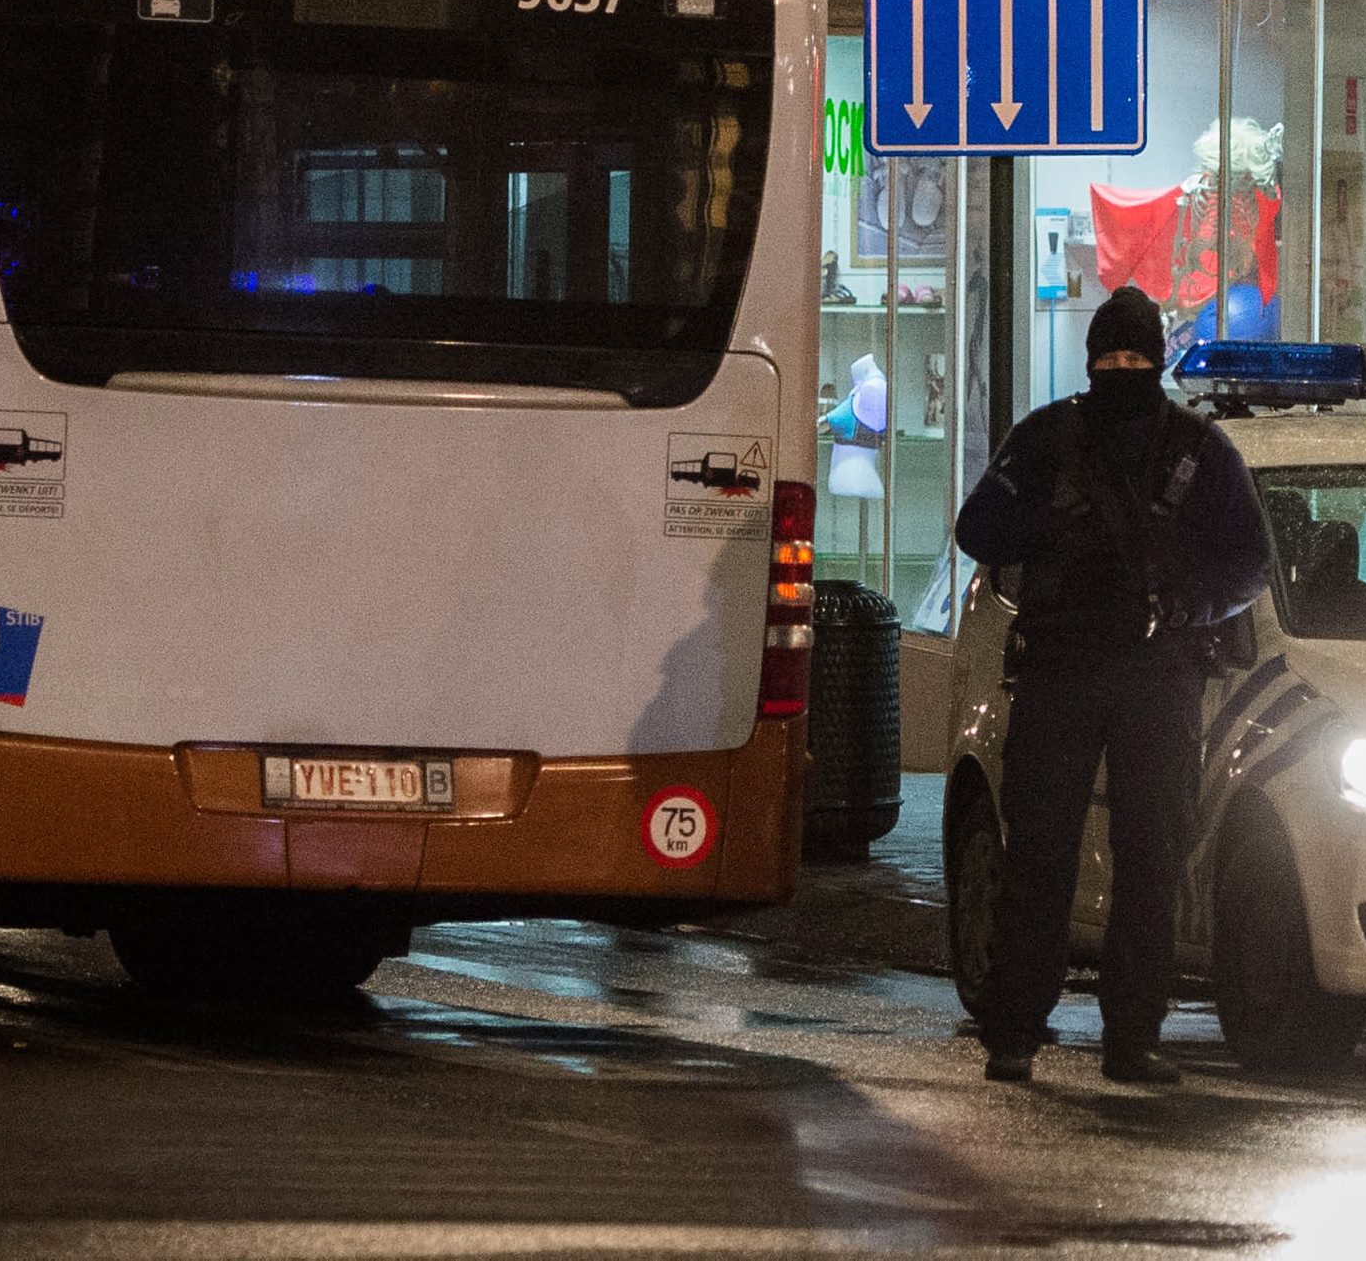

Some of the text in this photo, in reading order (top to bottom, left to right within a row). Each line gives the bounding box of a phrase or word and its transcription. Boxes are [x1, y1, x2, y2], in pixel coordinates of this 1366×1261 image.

[669, 506, 686, 514] PAS
[704, 508, 742, 518] ZWENKT
[6, 610, 41, 627] STIB
[429, 769, 449, 795] B
[661, 807, 696, 838] 75
[667, 839, 688, 852] km
